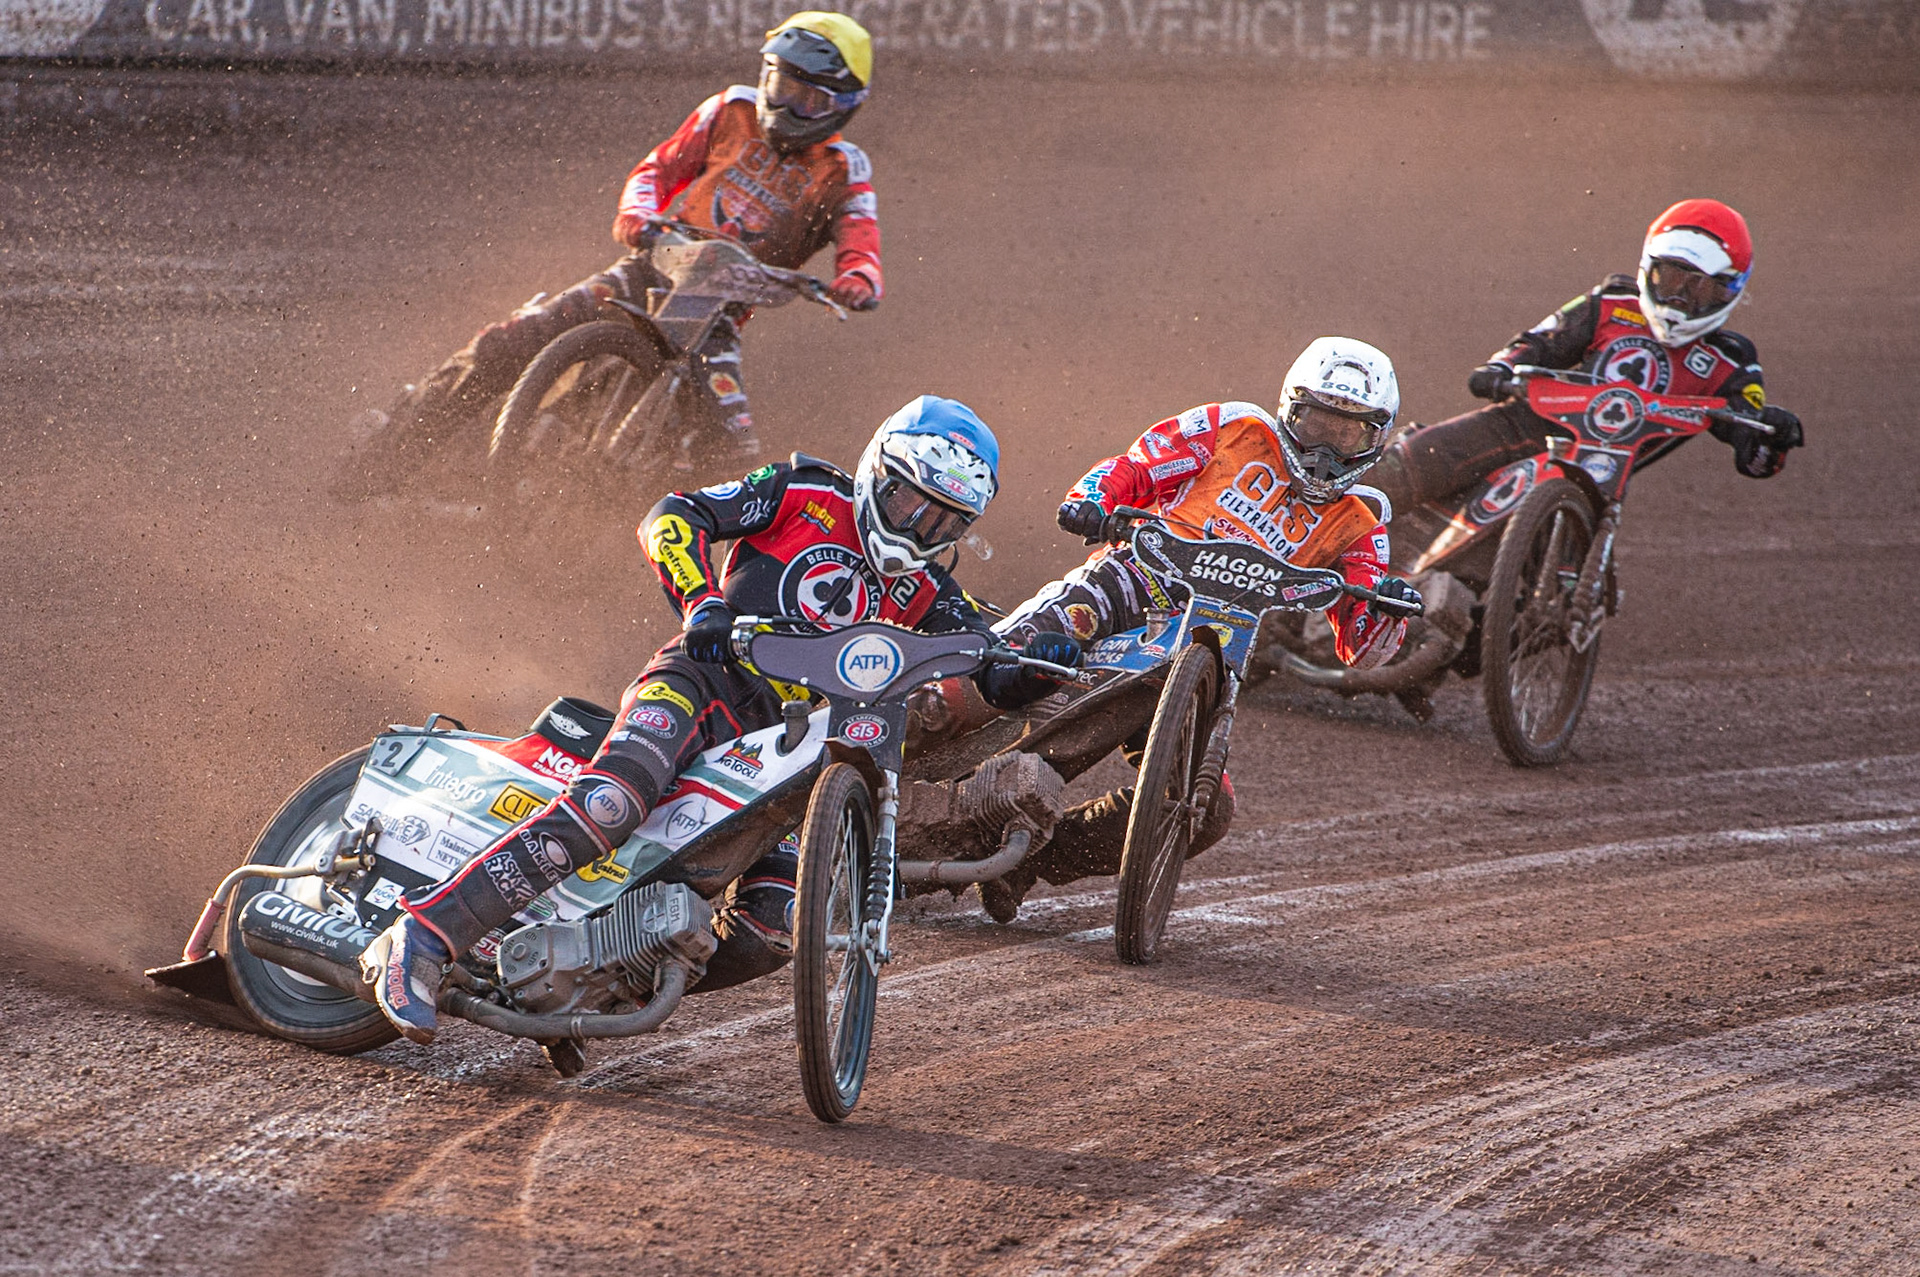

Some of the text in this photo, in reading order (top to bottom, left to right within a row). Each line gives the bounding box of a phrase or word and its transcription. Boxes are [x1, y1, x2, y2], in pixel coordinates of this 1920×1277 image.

[424, 0, 645, 48] MINIBUS
[1123, 0, 1353, 58] VEHICLE
[1368, 0, 1493, 60] HIRE
[1214, 517, 1260, 546] SWIN
[1219, 491, 1296, 561] FILTRATION
[653, 519, 695, 588] Rentruck
[806, 550, 844, 565] BELLE
[849, 556, 873, 580] VE
[1193, 550, 1284, 582] HAGON
[894, 577, 915, 605] 2
[1189, 564, 1277, 597] SHOCKS
[1089, 639, 1133, 652] AGON
[848, 654, 888, 670] ATPI
[637, 711, 665, 726] STS
[850, 723, 875, 738] STS
[380, 741, 403, 768] 2
[424, 764, 487, 805] integro
[594, 793, 621, 818] ATPI
[672, 812, 698, 832] ATPI
[373, 886, 397, 901] FUCHS
